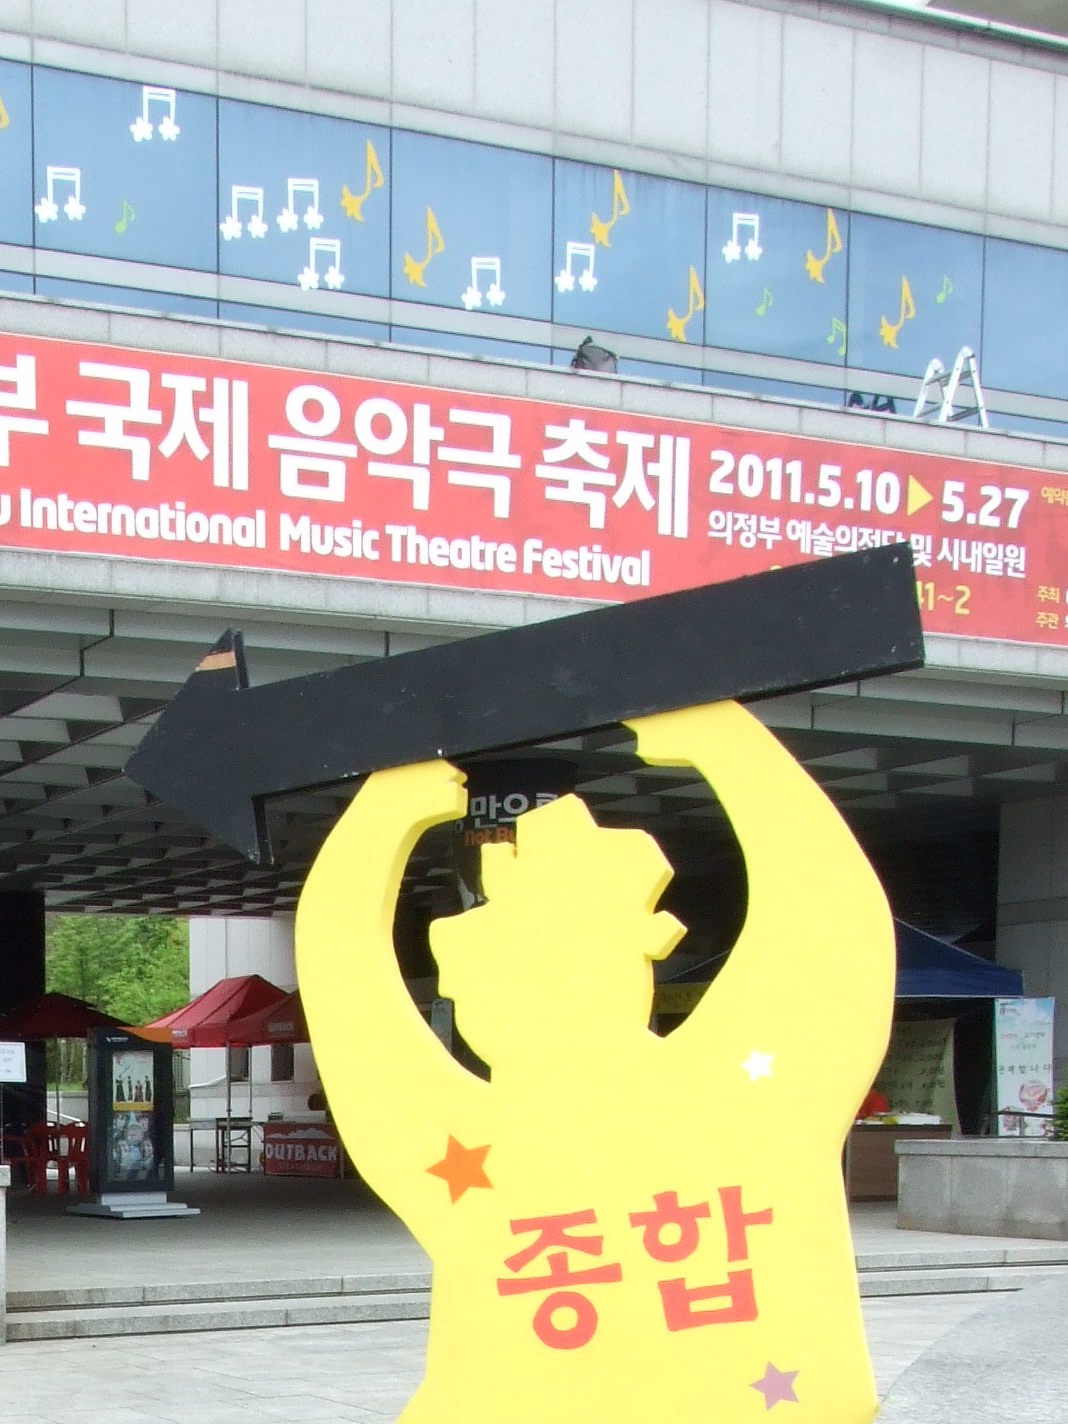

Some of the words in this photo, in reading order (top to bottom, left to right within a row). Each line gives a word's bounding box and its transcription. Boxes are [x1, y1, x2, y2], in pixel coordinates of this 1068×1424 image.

[65, 361, 249, 491] 국제
[268, 384, 521, 519] 음악극
[535, 419, 691, 538] 축제
[708, 449, 900, 515] 2011.5.10
[942, 480, 1030, 528] 5.27
[20, 488, 266, 549] International
[279, 513, 380, 561] Music
[385, 524, 516, 573] Theatre
[523, 538, 650, 586] Festival
[707, 510, 782, 550] 의정부
[911, 533, 932, 567] 및
[937, 537, 1026, 579] 시내일원
[265, 1143, 337, 1161] OUTBACK
[496, 1185, 773, 1350] 종합
